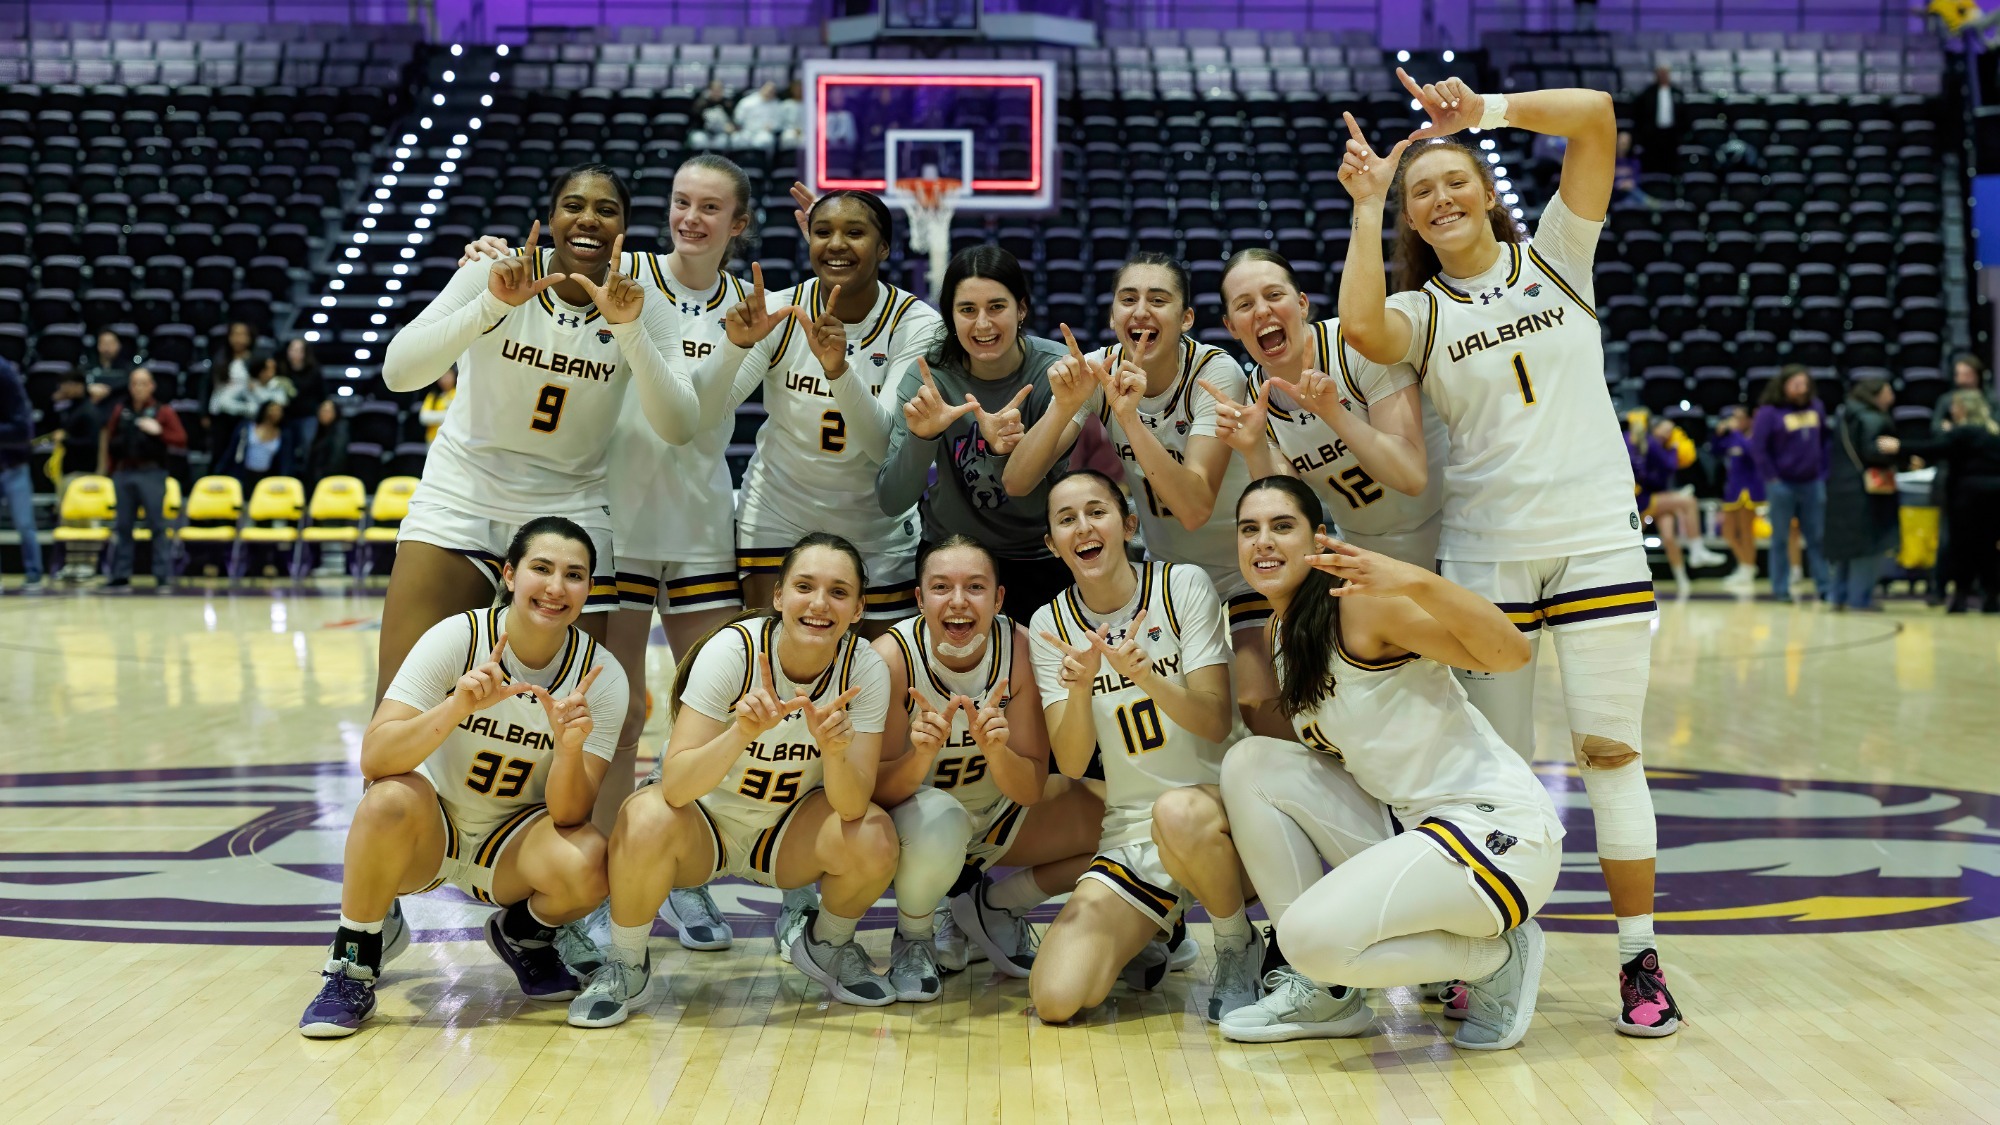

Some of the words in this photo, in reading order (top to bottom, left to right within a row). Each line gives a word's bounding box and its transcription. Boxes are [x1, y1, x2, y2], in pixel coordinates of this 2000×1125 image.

[1447, 306, 1565, 363] UALBANY
[502, 339, 616, 382] UALBANY
[1511, 351, 1537, 408] 1
[530, 383, 569, 434] 9
[820, 409, 846, 454] 2
[1292, 439, 1350, 473] ALBA
[1326, 464, 1385, 510] 12
[1114, 696, 1168, 756] 10
[464, 749, 537, 799] 33
[745, 741, 821, 762] ALBAN
[933, 755, 988, 789] 55
[737, 767, 805, 805] 35
